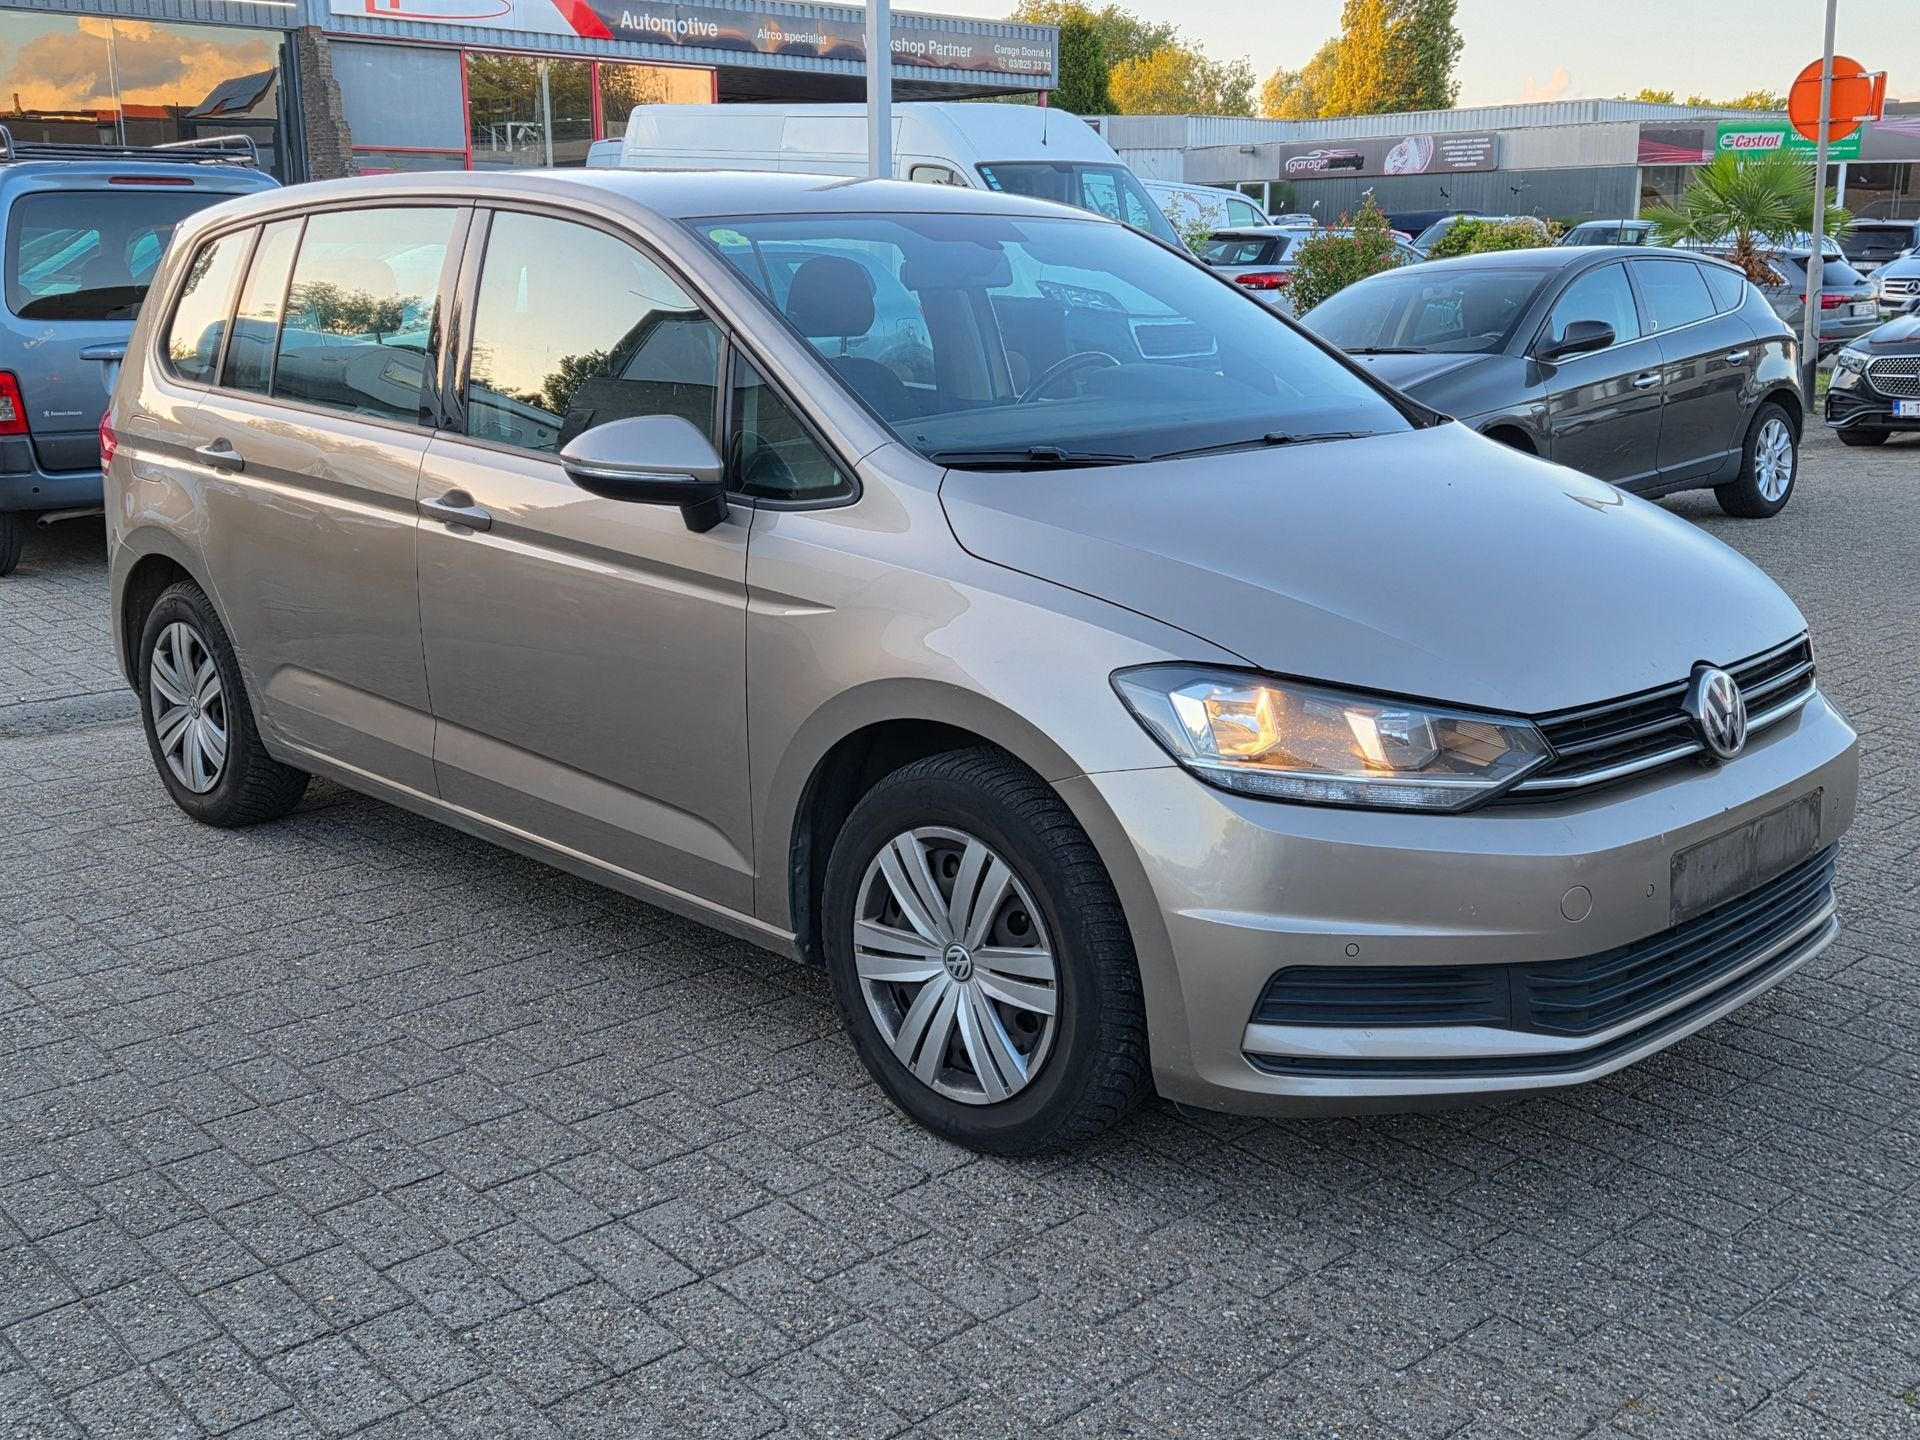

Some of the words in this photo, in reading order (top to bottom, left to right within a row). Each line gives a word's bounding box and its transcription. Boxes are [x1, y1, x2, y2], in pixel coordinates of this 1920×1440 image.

[620, 10, 718, 36] Automotive
[757, 28, 782, 40] Airco
[784, 32, 827, 46] specialist
[929, 40, 973, 57] Partner
[994, 44, 1020, 57] Garage
[1021, 47, 1045, 57] Donné
[1008, 58, 1032, 69] 03/825
[1033, 61, 1042, 70] 33
[1735, 135, 1780, 148] Castrol
[1289, 159, 1328, 173] garage
